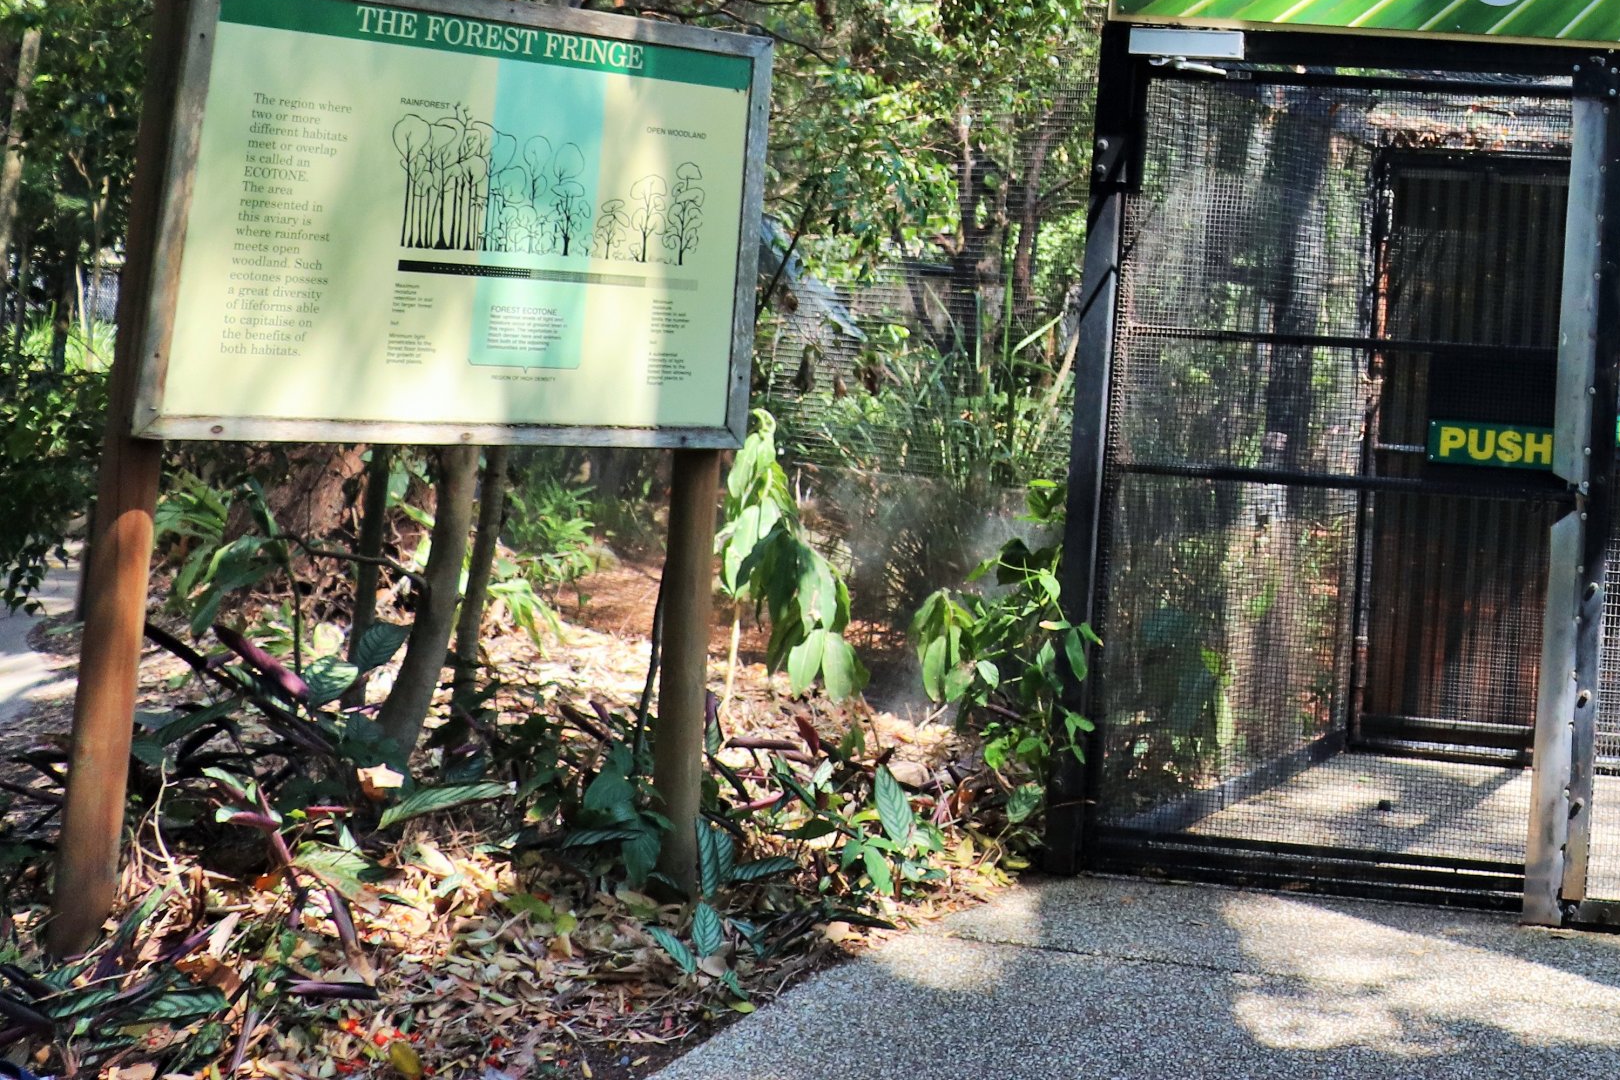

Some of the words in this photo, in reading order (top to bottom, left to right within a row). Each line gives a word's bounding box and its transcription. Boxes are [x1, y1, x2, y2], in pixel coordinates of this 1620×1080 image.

[356, 5, 417, 39] THE
[424, 15, 538, 55] FOREST
[543, 32, 644, 70] FRINGE
[253, 92, 276, 105] The
[280, 98, 315, 110] region
[318, 101, 353, 114] where
[400, 97, 450, 109] RAINFOREST
[251, 109, 272, 119] two
[275, 113, 288, 121] or
[291, 115, 321, 125] more
[249, 122, 299, 137] different
[302, 128, 348, 142] habitats
[647, 126, 666, 135] OPEN
[667, 129, 707, 140] WOODLAND
[247, 139, 276, 150] meet
[280, 142, 293, 151] or
[296, 144, 338, 157] overlap
[245, 151, 256, 163] is
[259, 153, 293, 166] called
[296, 160, 311, 168] an
[243, 165, 309, 182] ECOTONE.
[241, 180, 265, 192] The
[267, 186, 293, 195] area
[239, 198, 309, 212] represented
[312, 202, 324, 213] in
[238, 211, 260, 223] this
[263, 214, 298, 227] aviary
[302, 216, 312, 226] is
[235, 225, 271, 238] where
[274, 229, 331, 242] rainforest
[233, 242, 269, 253] meets
[272, 245, 301, 255] open
[231, 255, 291, 269] woodland.
[294, 258, 322, 271] Such
[229, 271, 282, 282] ecotones
[285, 275, 329, 286] possess
[227, 286, 234, 295] a
[238, 286, 269, 298] great
[272, 287, 323, 301] diversity
[225, 299, 239, 309] of
[240, 299, 293, 312] lifeforms
[296, 302, 320, 314] able
[490, 305, 520, 314] FOREST
[522, 306, 558, 316] ECOTONE
[224, 314, 236, 324] to
[239, 315, 295, 328] capitalise
[298, 319, 313, 328] on
[222, 328, 241, 340] the
[245, 328, 291, 342] benefits
[294, 331, 307, 342] of
[220, 342, 247, 354] both
[250, 343, 301, 357] habitats.
[1438, 426, 1553, 465] PUSH
